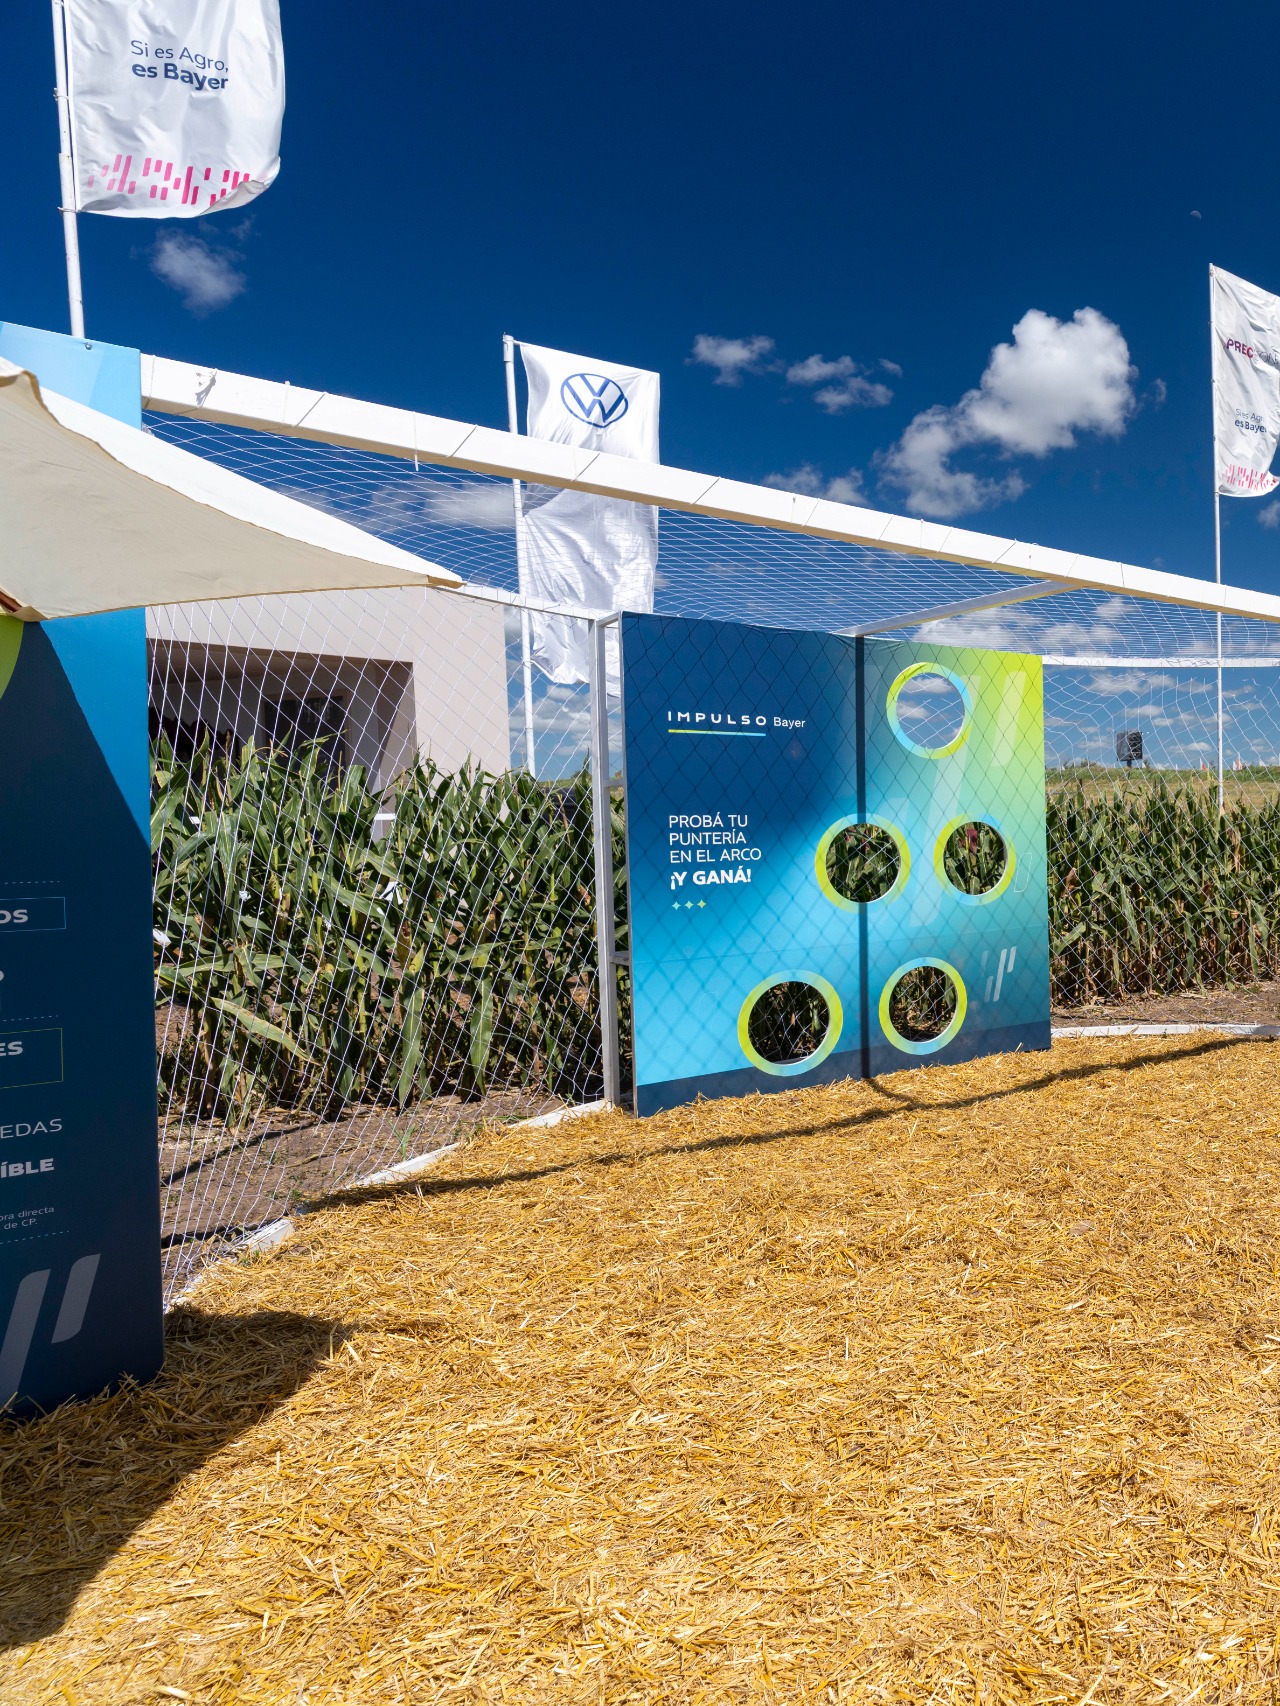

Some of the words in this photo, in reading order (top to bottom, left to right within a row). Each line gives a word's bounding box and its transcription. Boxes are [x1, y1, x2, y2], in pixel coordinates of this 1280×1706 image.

[130, 39, 149, 58] Si
[154, 47, 174, 59] es
[178, 46, 229, 73] Agro,
[131, 63, 158, 79] es
[163, 62, 229, 91] Bayer
[1234, 419, 1244, 428] es
[667, 710, 767, 726] IMPULSO
[773, 716, 806, 730] Bayer
[668, 811, 724, 829] PROBÁ
[727, 814, 748, 828] TU
[669, 828, 747, 846] PUNTERÍA
[670, 849, 692, 864] EN
[696, 849, 716, 863] EL
[719, 848, 762, 862] ARCO
[670, 871, 688, 891] ¡Y
[692, 865, 752, 886] GANÁ!
[0, 1118, 63, 1139] EDAS
[0, 1158, 55, 1179] ÍBLE
[17, 1206, 55, 1219] directa
[3, 1221, 18, 1230] de
